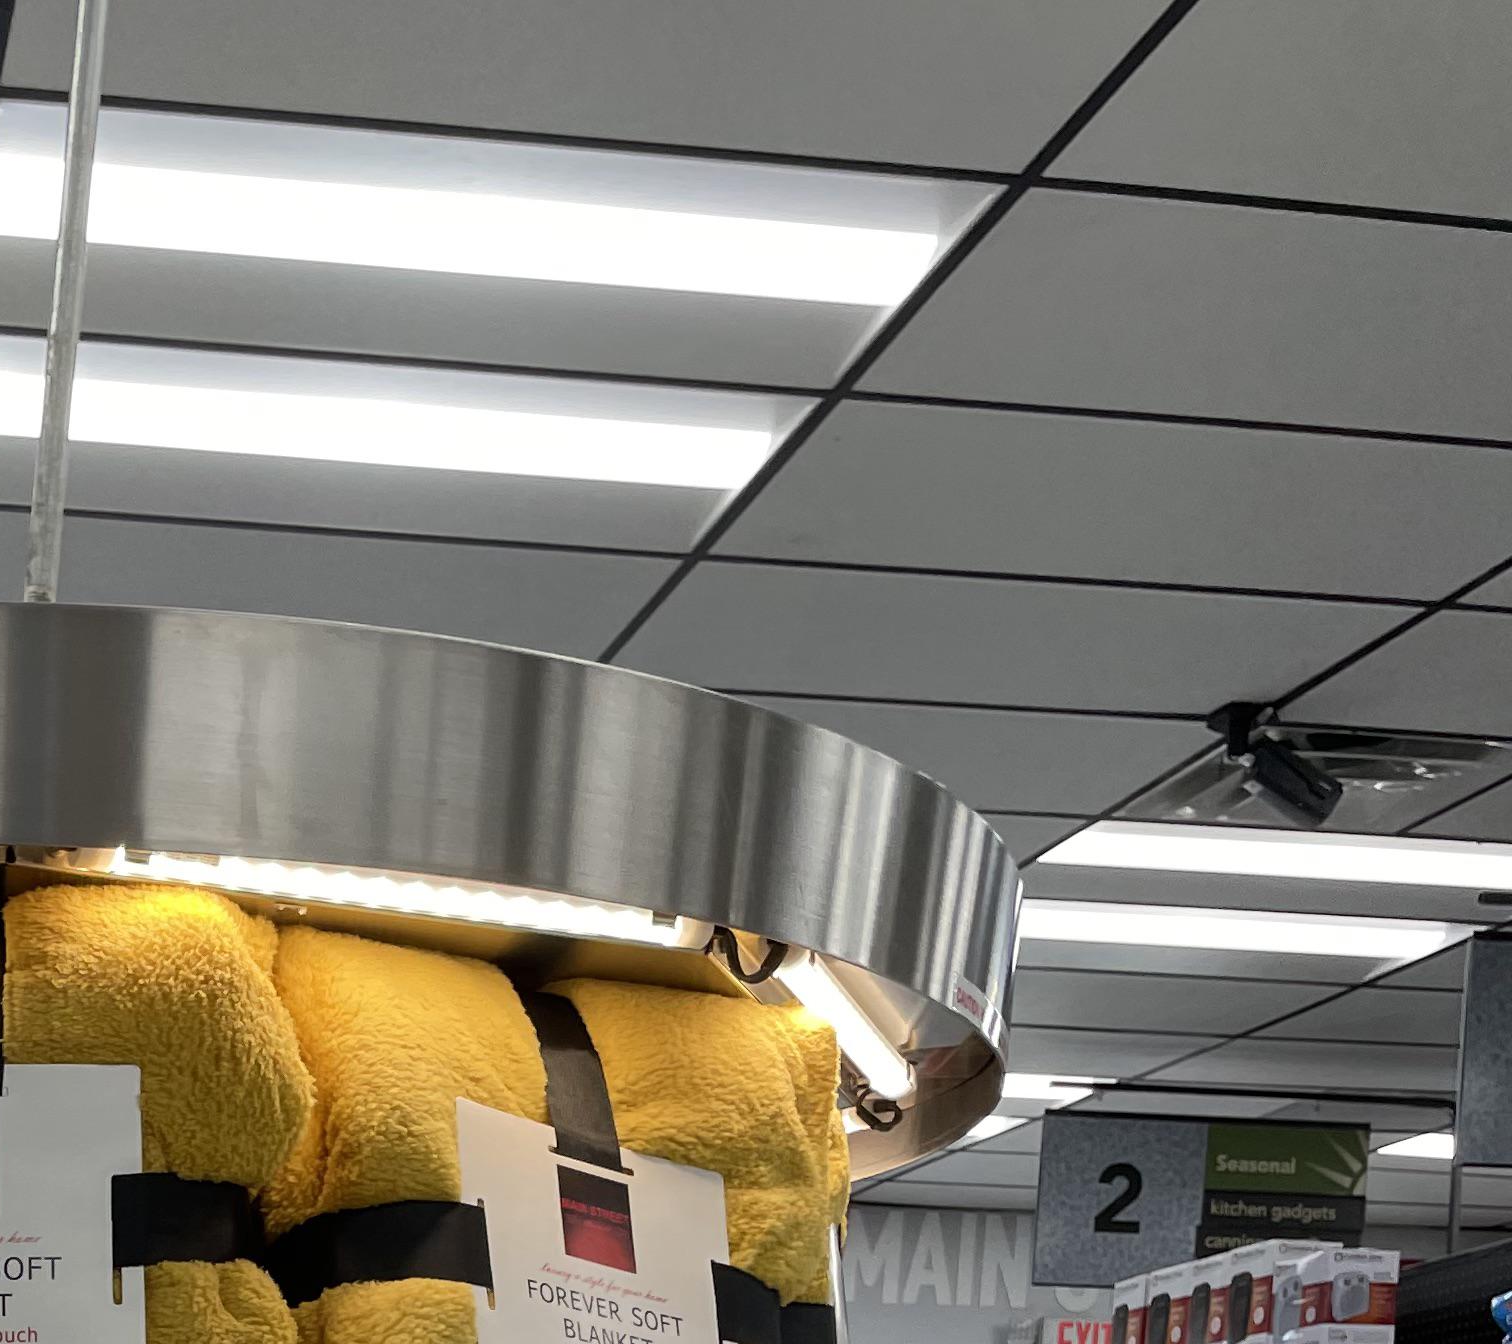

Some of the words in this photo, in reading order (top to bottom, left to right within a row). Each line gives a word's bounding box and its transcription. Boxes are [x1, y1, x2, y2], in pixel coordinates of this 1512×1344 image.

[1216, 1154, 1296, 1175] Seasonal
[1094, 1162, 1143, 1235] 2
[1210, 1199, 1267, 1218] kitchen
[1271, 1202, 1336, 1224] gadgets
[844, 1209, 1034, 1309] MAIN
[528, 1279, 622, 1323] FOREVER
[632, 1307, 683, 1336] SOFT
